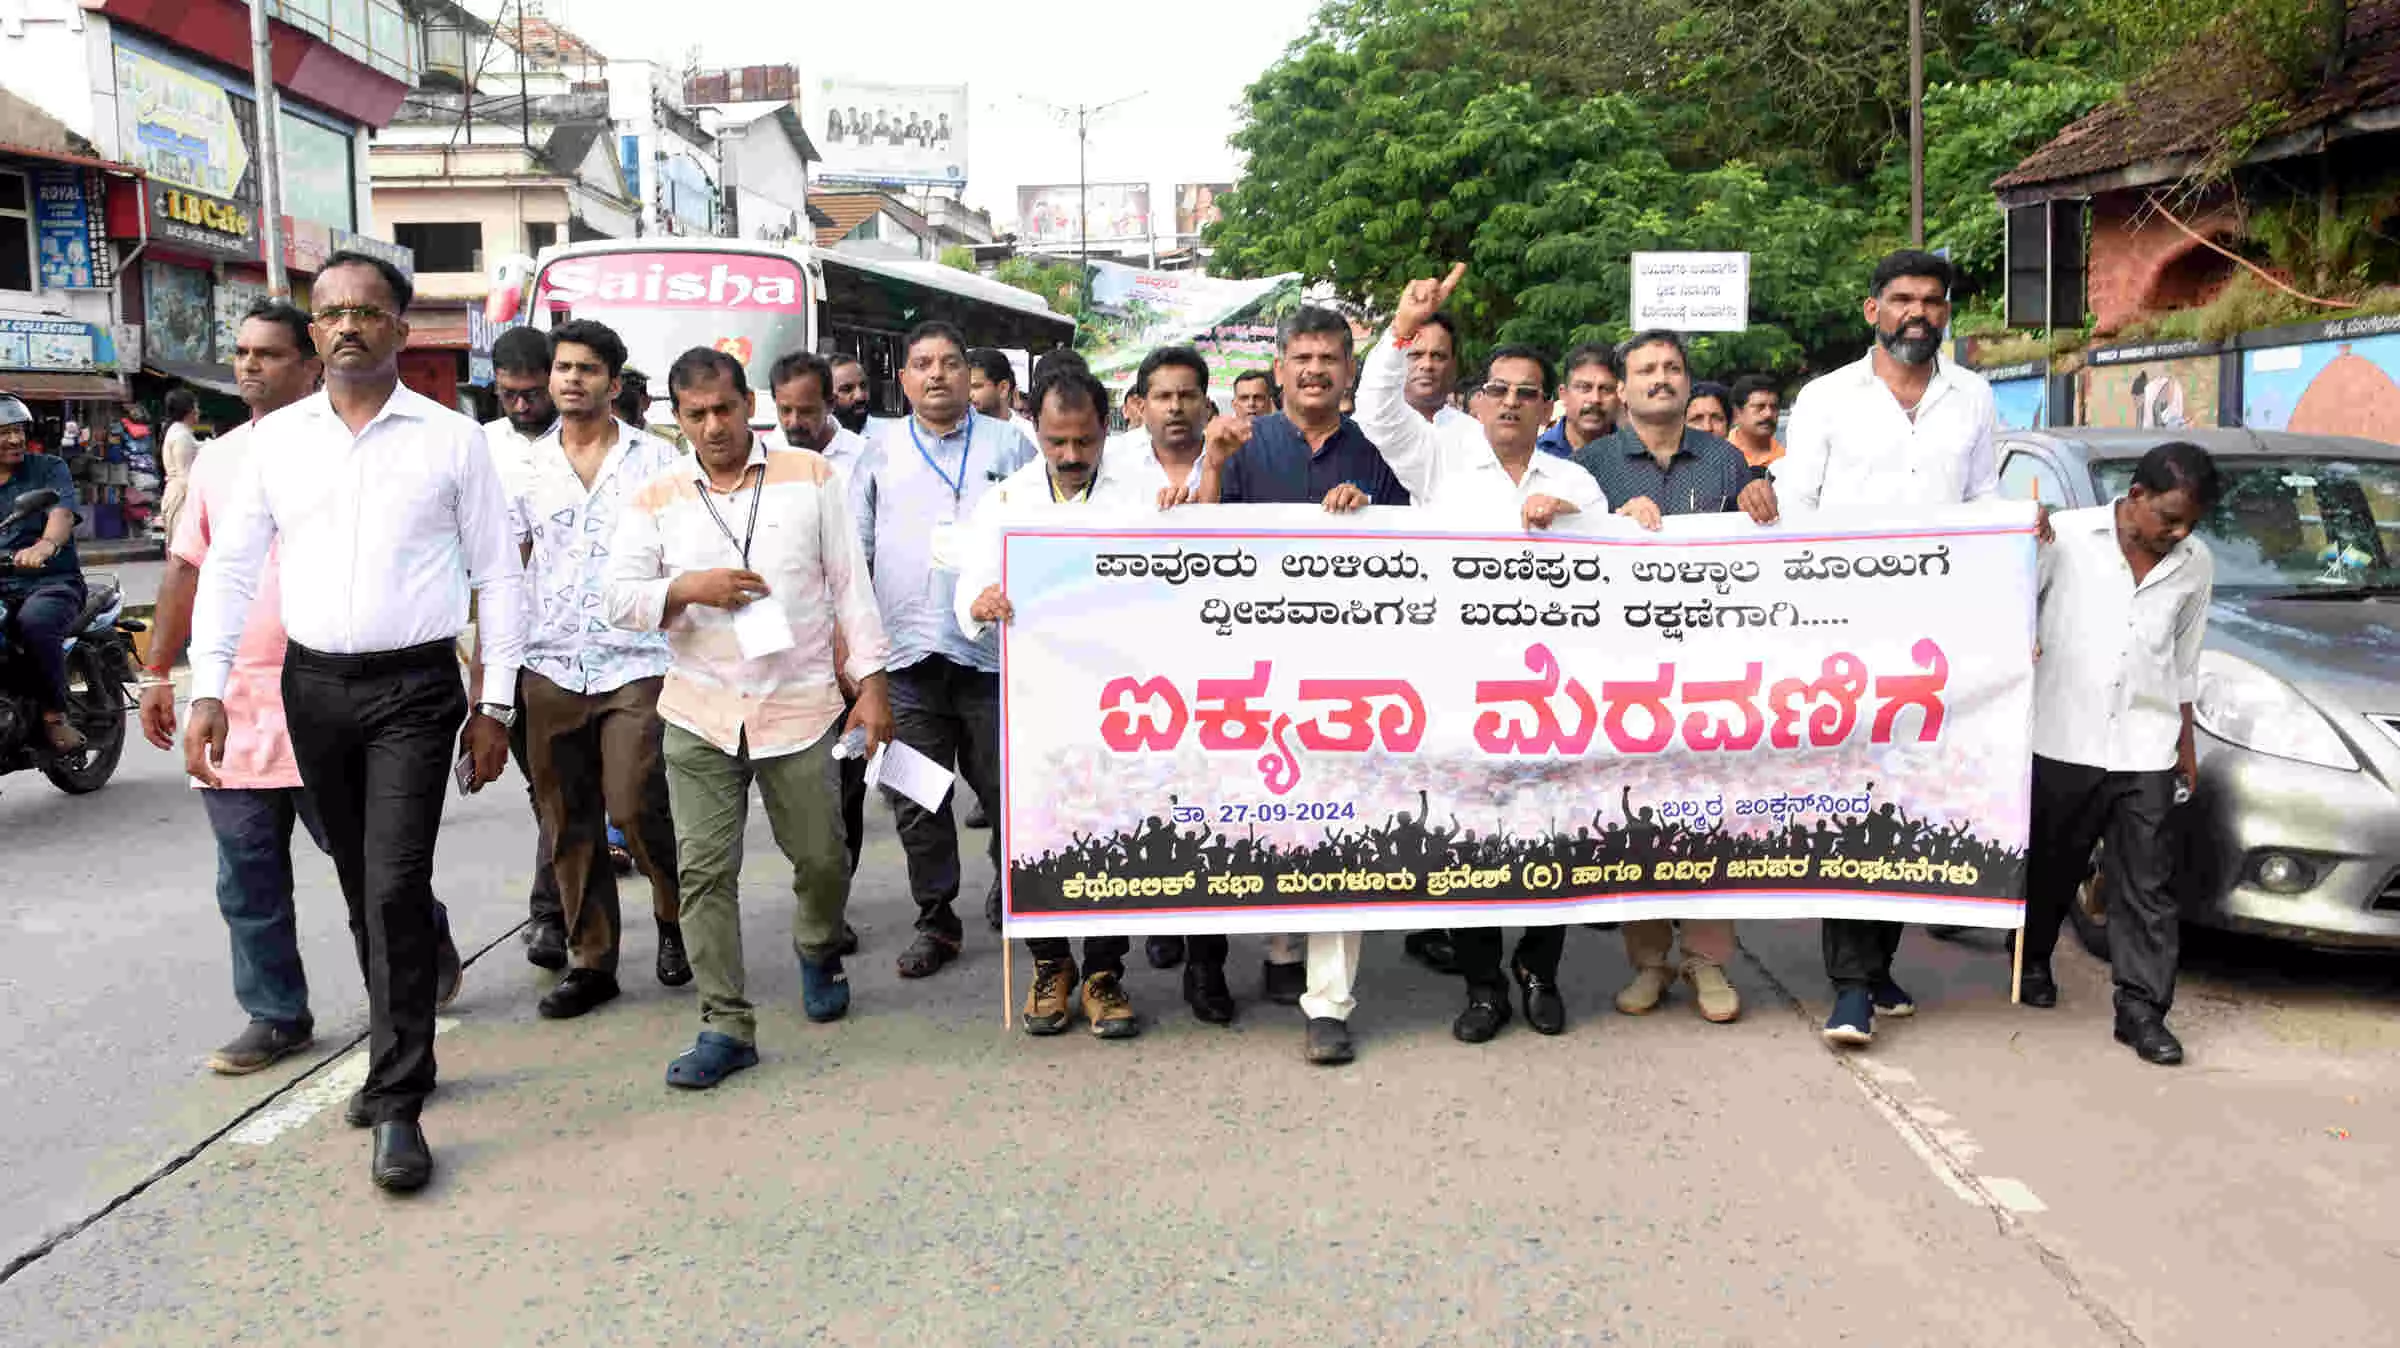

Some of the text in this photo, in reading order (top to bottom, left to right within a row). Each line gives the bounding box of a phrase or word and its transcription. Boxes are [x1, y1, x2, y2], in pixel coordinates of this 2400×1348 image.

[547, 264, 796, 305] Saisha
[1096, 549, 1256, 584] ಪಾವೂರು
[1282, 552, 1427, 579] ಉಳಿಯ,
[1453, 551, 1609, 588] ರಾಣಿಪುರ,
[1461, 600, 1600, 627] ಬದುಕಿನ
[1100, 637, 1948, 794] ಐಕ್ಯತಾ ಮೆರವಣಿಗೆ
[1220, 802, 1355, 823] 27-09-2024
[1208, 871, 1263, 897] ಸಭಾ
[1277, 868, 1416, 892] ಮಂಗಳೂರು
[1572, 860, 1641, 884] ಹಾಗೂ
[1654, 857, 1717, 882] ವಿವಿಧ
[1727, 855, 1809, 877] ಜನಪರ
